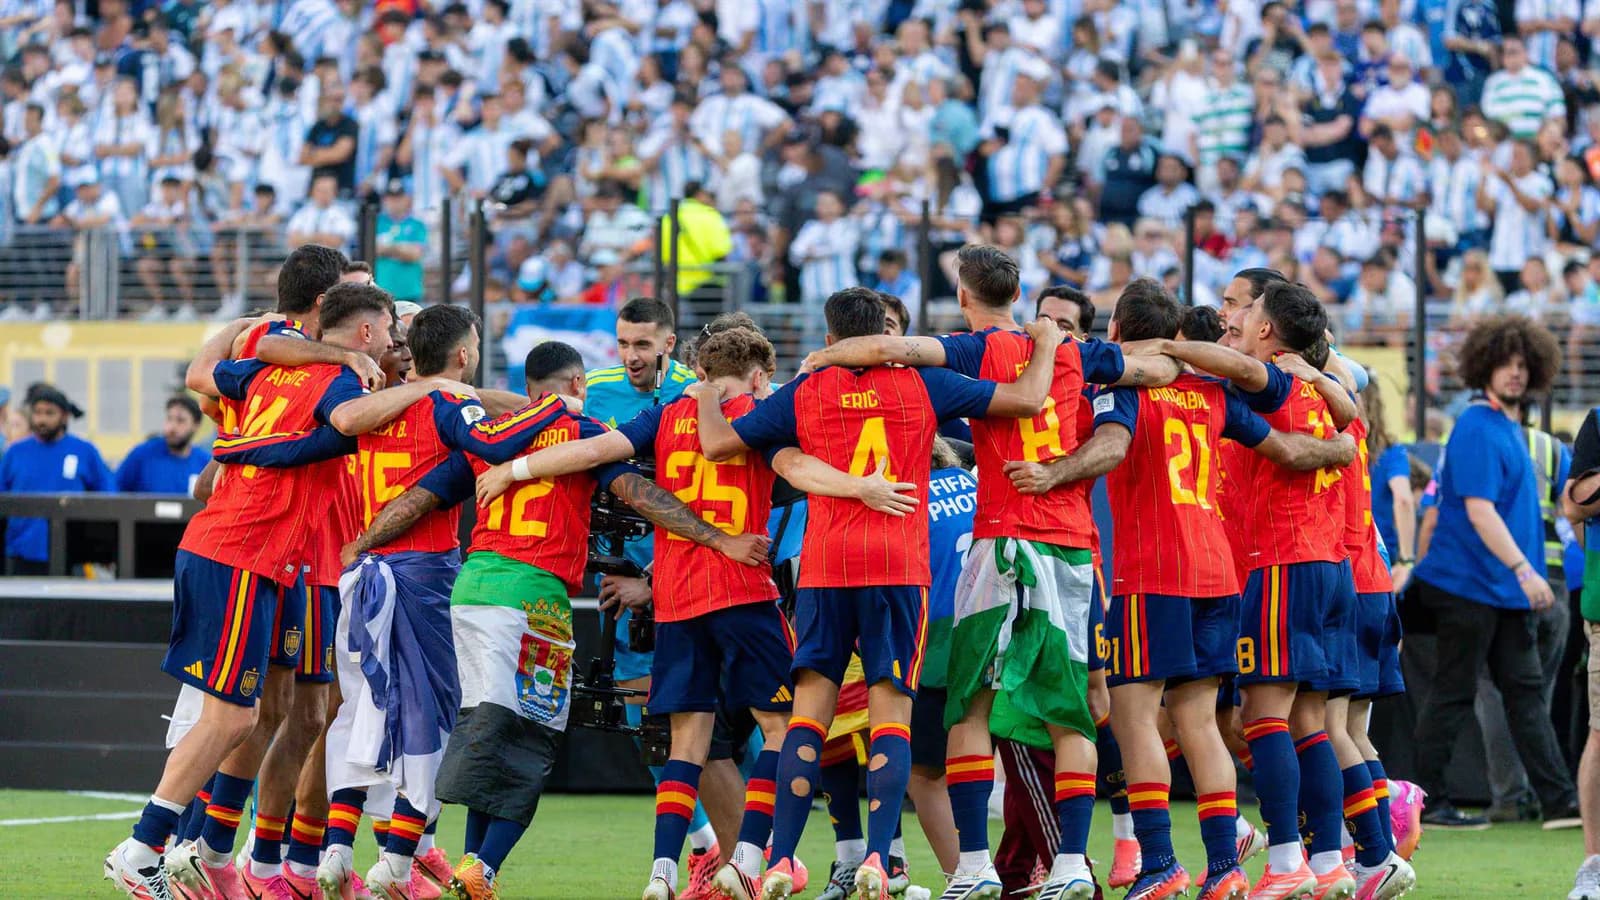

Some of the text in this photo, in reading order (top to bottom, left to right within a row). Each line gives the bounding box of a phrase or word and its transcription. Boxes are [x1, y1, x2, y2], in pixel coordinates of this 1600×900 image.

[841, 390, 878, 409] ERIC
[849, 416, 898, 483] 4
[1163, 416, 1212, 510] 21
[359, 449, 411, 531] 15
[666, 450, 748, 541] 25
[928, 491, 977, 522] PHOT
[929, 474, 976, 496] FIFA
